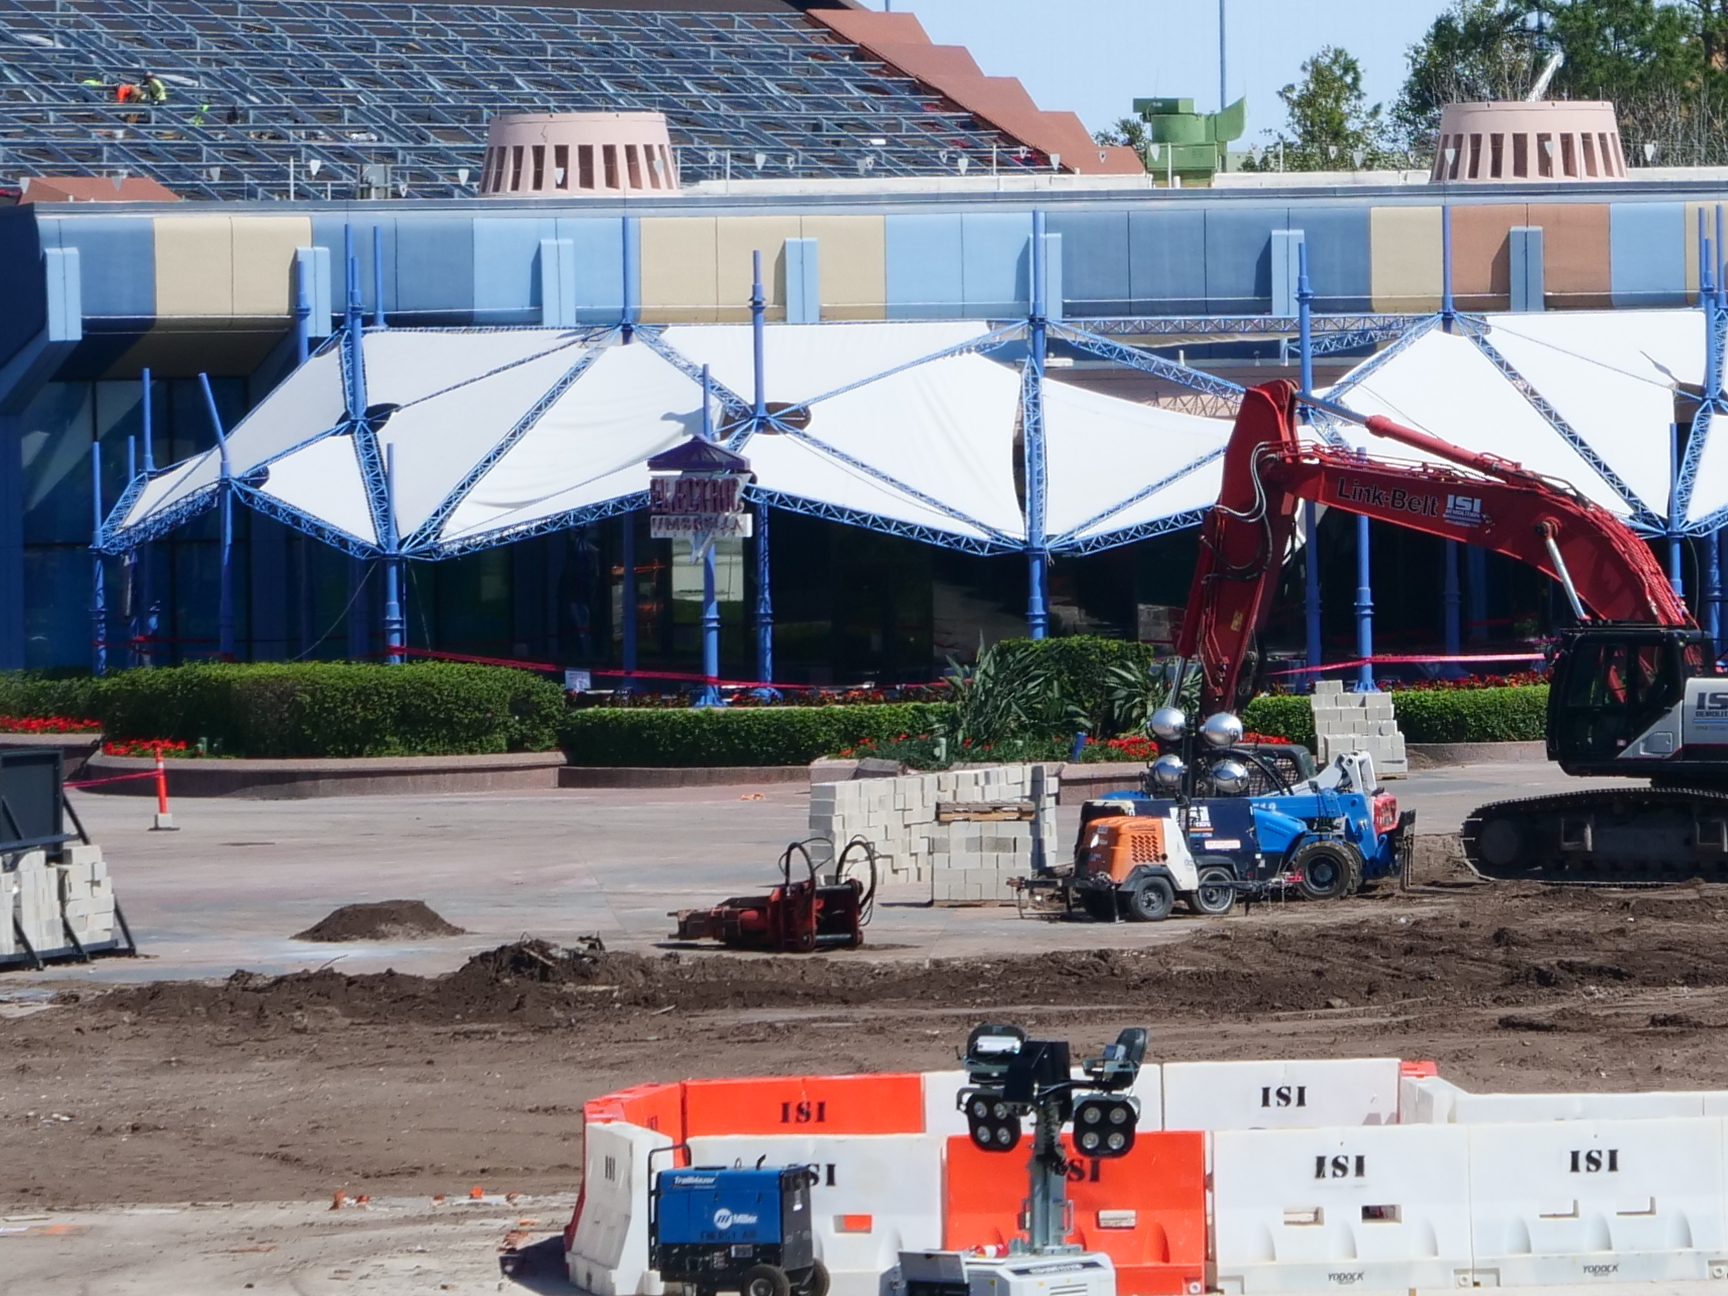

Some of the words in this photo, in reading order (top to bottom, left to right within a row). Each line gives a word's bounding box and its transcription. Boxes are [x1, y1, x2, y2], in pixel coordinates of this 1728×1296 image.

[1337, 477, 1438, 517] Link-Belt
[1446, 494, 1482, 512] ISI
[1261, 1086, 1306, 1107] ISI
[779, 1101, 826, 1124] ISI
[1066, 1158, 1100, 1182] SI
[1314, 1155, 1366, 1179] ISI
[1570, 1149, 1619, 1173] ISI
[734, 1213, 758, 1224] Miller
[1327, 1271, 1364, 1281] YODOCK
[1583, 1263, 1620, 1274] YODOCK
